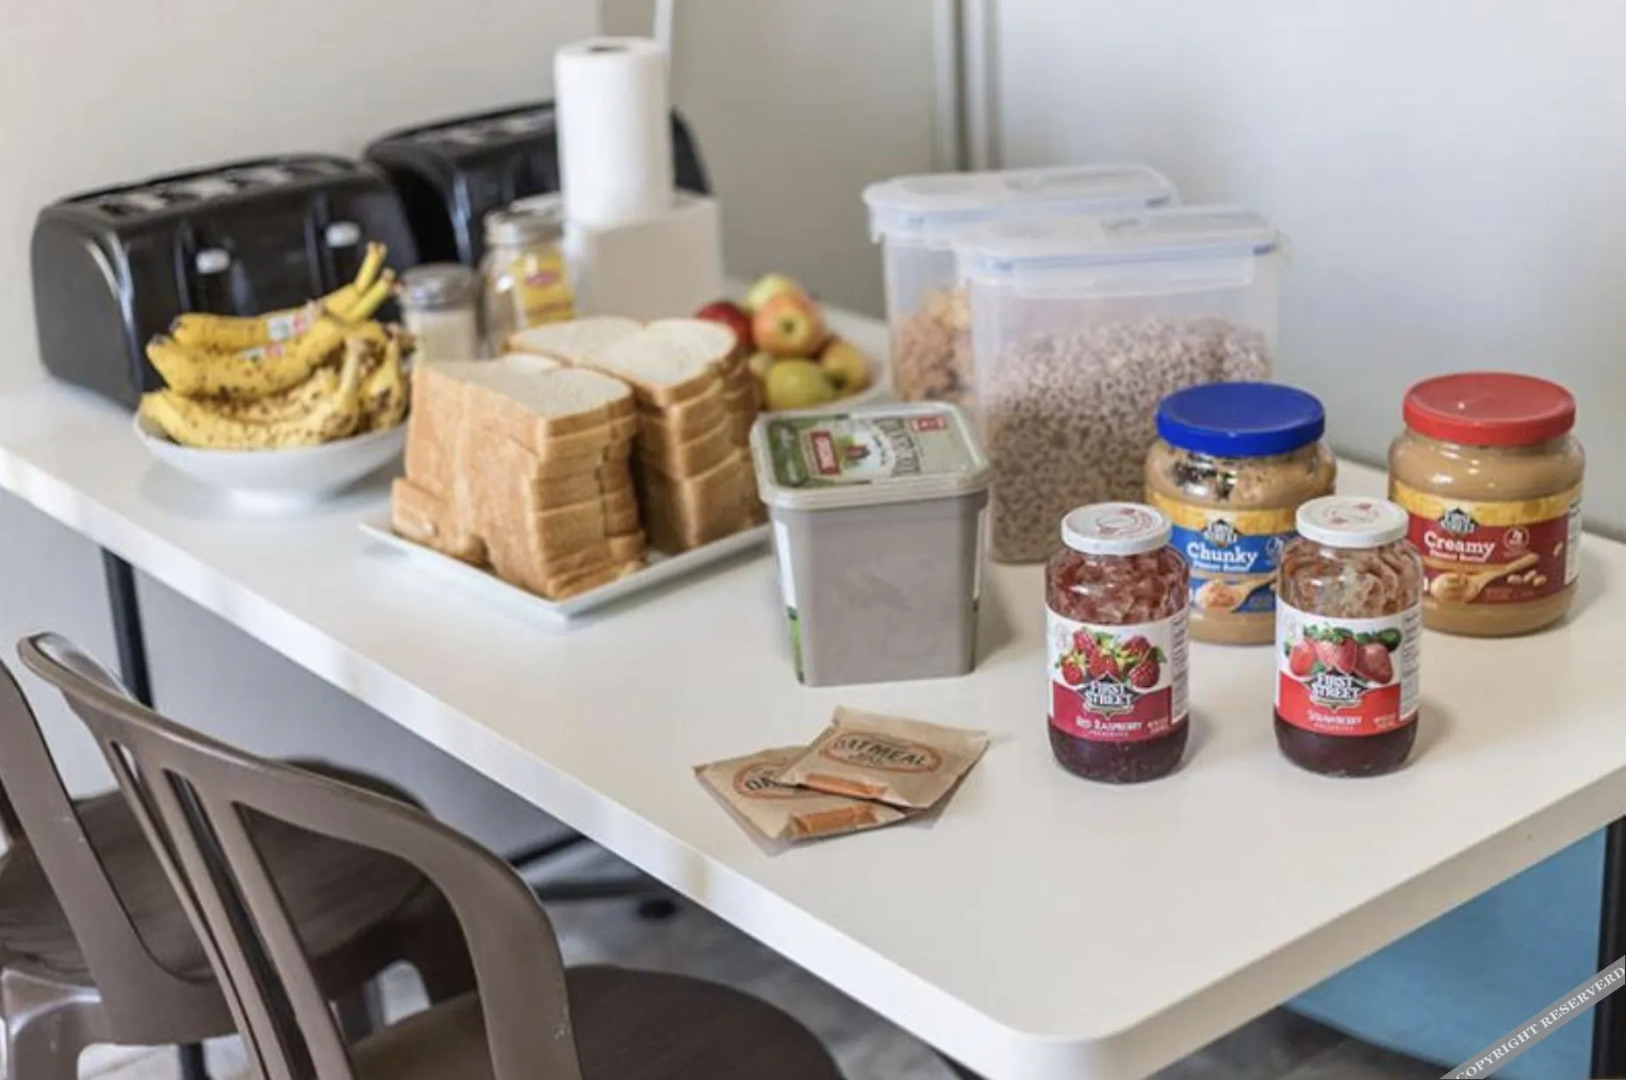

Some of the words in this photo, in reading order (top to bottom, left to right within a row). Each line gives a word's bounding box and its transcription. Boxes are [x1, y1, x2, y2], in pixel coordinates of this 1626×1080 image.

[1186, 541, 1258, 569] Chunky
[1424, 531, 1496, 560] Creamy
[1089, 680, 1126, 694] FIRST
[1316, 673, 1353, 687] FIRST
[833, 738, 926, 767] OATMEAL
